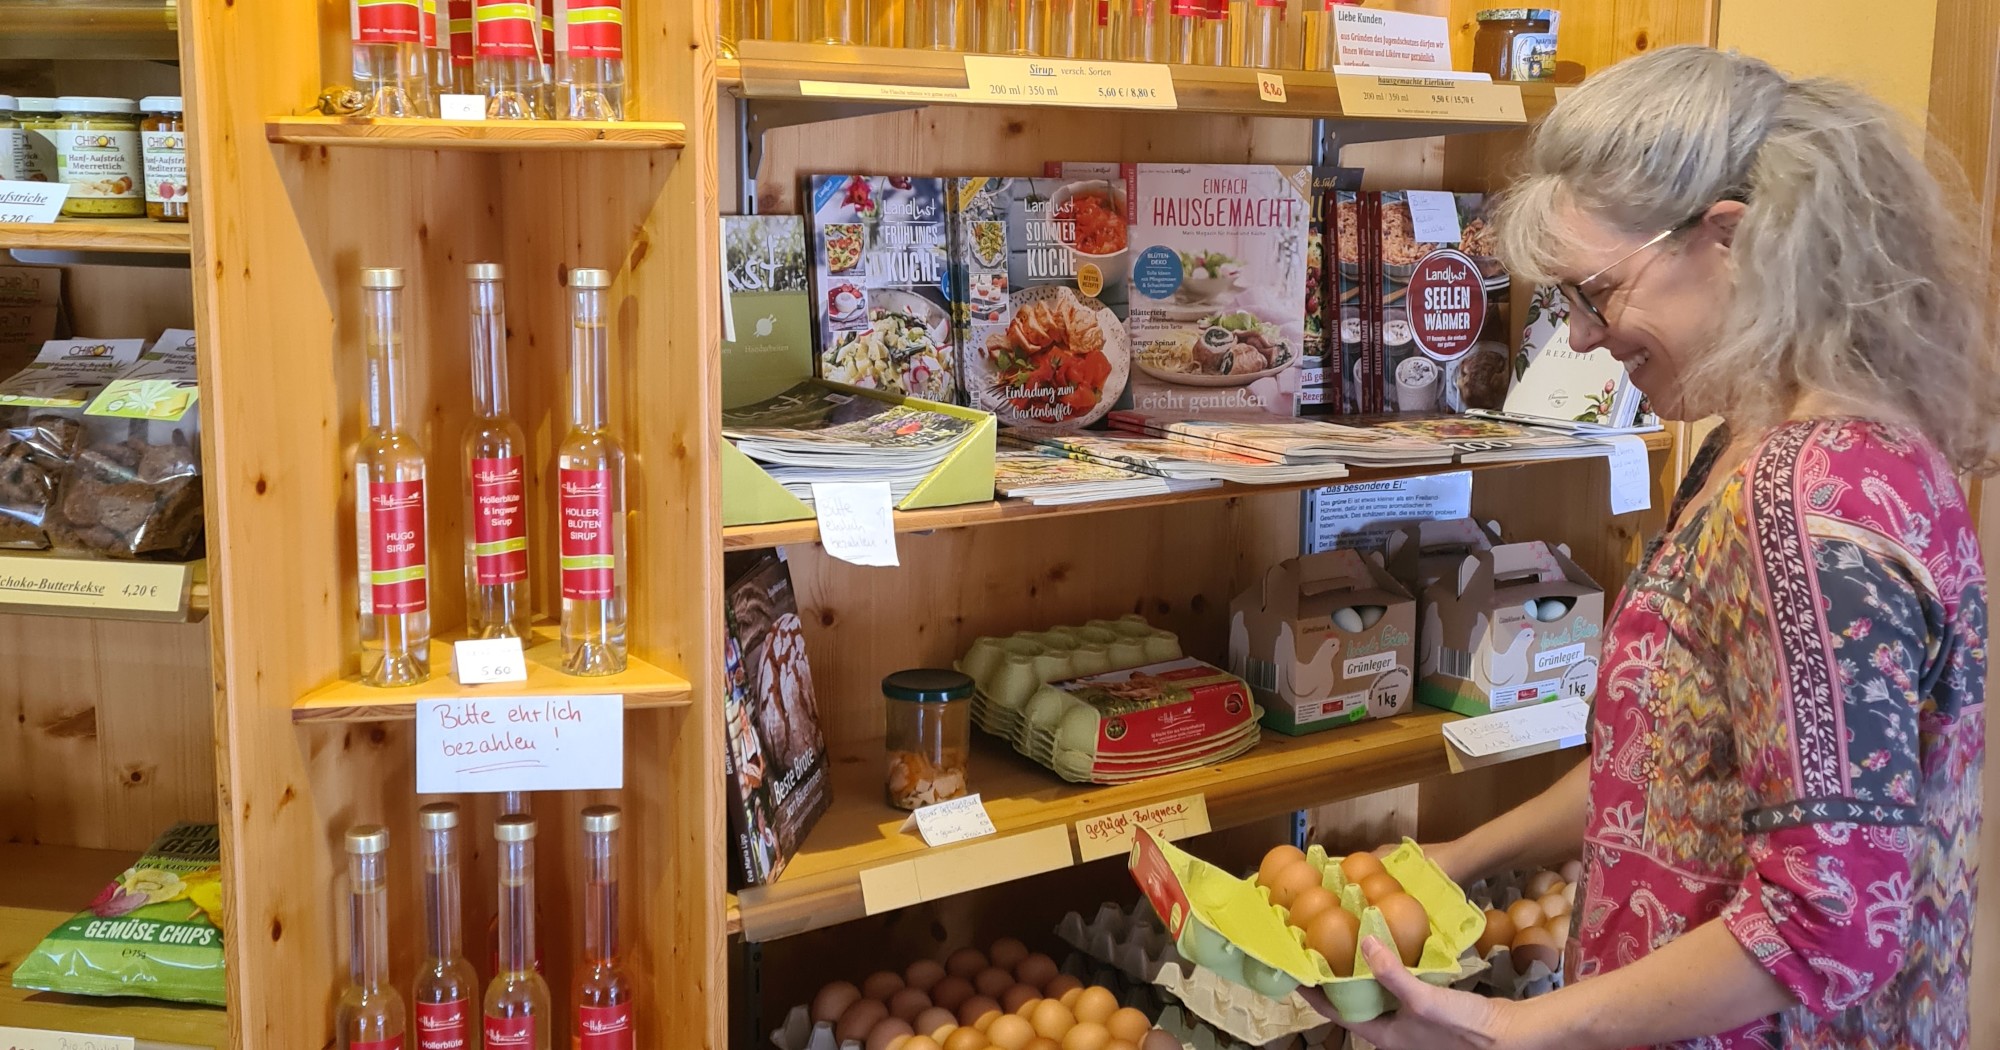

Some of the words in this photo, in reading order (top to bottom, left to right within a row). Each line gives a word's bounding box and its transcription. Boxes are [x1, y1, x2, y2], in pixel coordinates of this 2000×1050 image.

[1338, 10, 1356, 22] Liebe
[1341, 33, 1350, 41] aus
[1350, 32, 1373, 43] Gründen
[1374, 35, 1382, 43] des
[1383, 36, 1419, 47] Jugendschutzes
[1420, 39, 1435, 49] dürfen
[1342, 46, 1357, 55] Ihnen
[1358, 47, 1374, 56] Weine
[1375, 49, 1384, 57] und
[1385, 49, 1401, 58] Liköre
[1411, 52, 1435, 62] persönlich
[1030, 64, 1053, 76] Sirup
[1061, 67, 1086, 76] versch.
[1089, 67, 1112, 76] Sorten
[1424, 78, 1455, 88] Eierliköre
[990, 84, 1007, 95] 200
[1009, 85, 1021, 95] ml
[1029, 85, 1044, 95] 350
[1047, 86, 1058, 96] ml
[1098, 87, 1116, 98] 5,60
[1119, 88, 1124, 97] €
[1131, 88, 1149, 99] 8,80
[1150, 89, 1156, 98] €
[1363, 92, 1375, 100] 200
[1389, 93, 1399, 101] 350
[75, 135, 116, 147] CHIRON
[69, 154, 125, 162] Hanf-Aufstrich
[73, 162, 122, 170] Meerrettich
[1204, 179, 1247, 195] EINFACH
[0, 192, 48, 204] ufstriche
[1153, 198, 1297, 227] HAUSGEMACHT
[885, 221, 938, 245] FRÜHLINGS
[1026, 221, 1076, 241] SOMMER
[888, 247, 941, 282] KÜCHE
[1027, 243, 1078, 277] KÜCHE
[1424, 286, 1470, 310] SEELEN
[1424, 311, 1470, 330] WÄRMER
[1546, 349, 1595, 361] REZEPTE
[1005, 384, 1055, 402] Einladung
[1057, 385, 1074, 396] zum
[1133, 390, 1184, 410] Leicht
[1189, 388, 1268, 414] genießen
[1303, 391, 1324, 401] Rezep
[1012, 402, 1073, 421] Gartenbuffet
[1343, 481, 1390, 491] besondere
[492, 506, 517, 516] Ingwer
[491, 517, 512, 527] Sirup
[567, 518, 602, 528] BLÜTEN
[386, 531, 415, 541] HUGO
[570, 531, 597, 541] SIRUP
[386, 543, 415, 553] SIRUP
[0, 575, 105, 594] choko-Butterkekse
[122, 584, 147, 597] 4,20
[150, 586, 158, 597] €
[1347, 659, 1392, 674] Grünleger
[1538, 650, 1580, 668] Grünleger
[1569, 684, 1572, 695] 1
[1575, 681, 1586, 697] kg
[1378, 694, 1382, 706] 1
[1385, 691, 1397, 707] kg
[433, 702, 495, 729] Bitte
[508, 700, 581, 722] ehrlich
[442, 731, 536, 756] bezahlen
[774, 769, 796, 806] Beste
[794, 747, 814, 780] Brote
[1133, 804, 1189, 823] Bolognese
[84, 919, 158, 941] GEMÜSE
[159, 925, 215, 945] CHIPS
